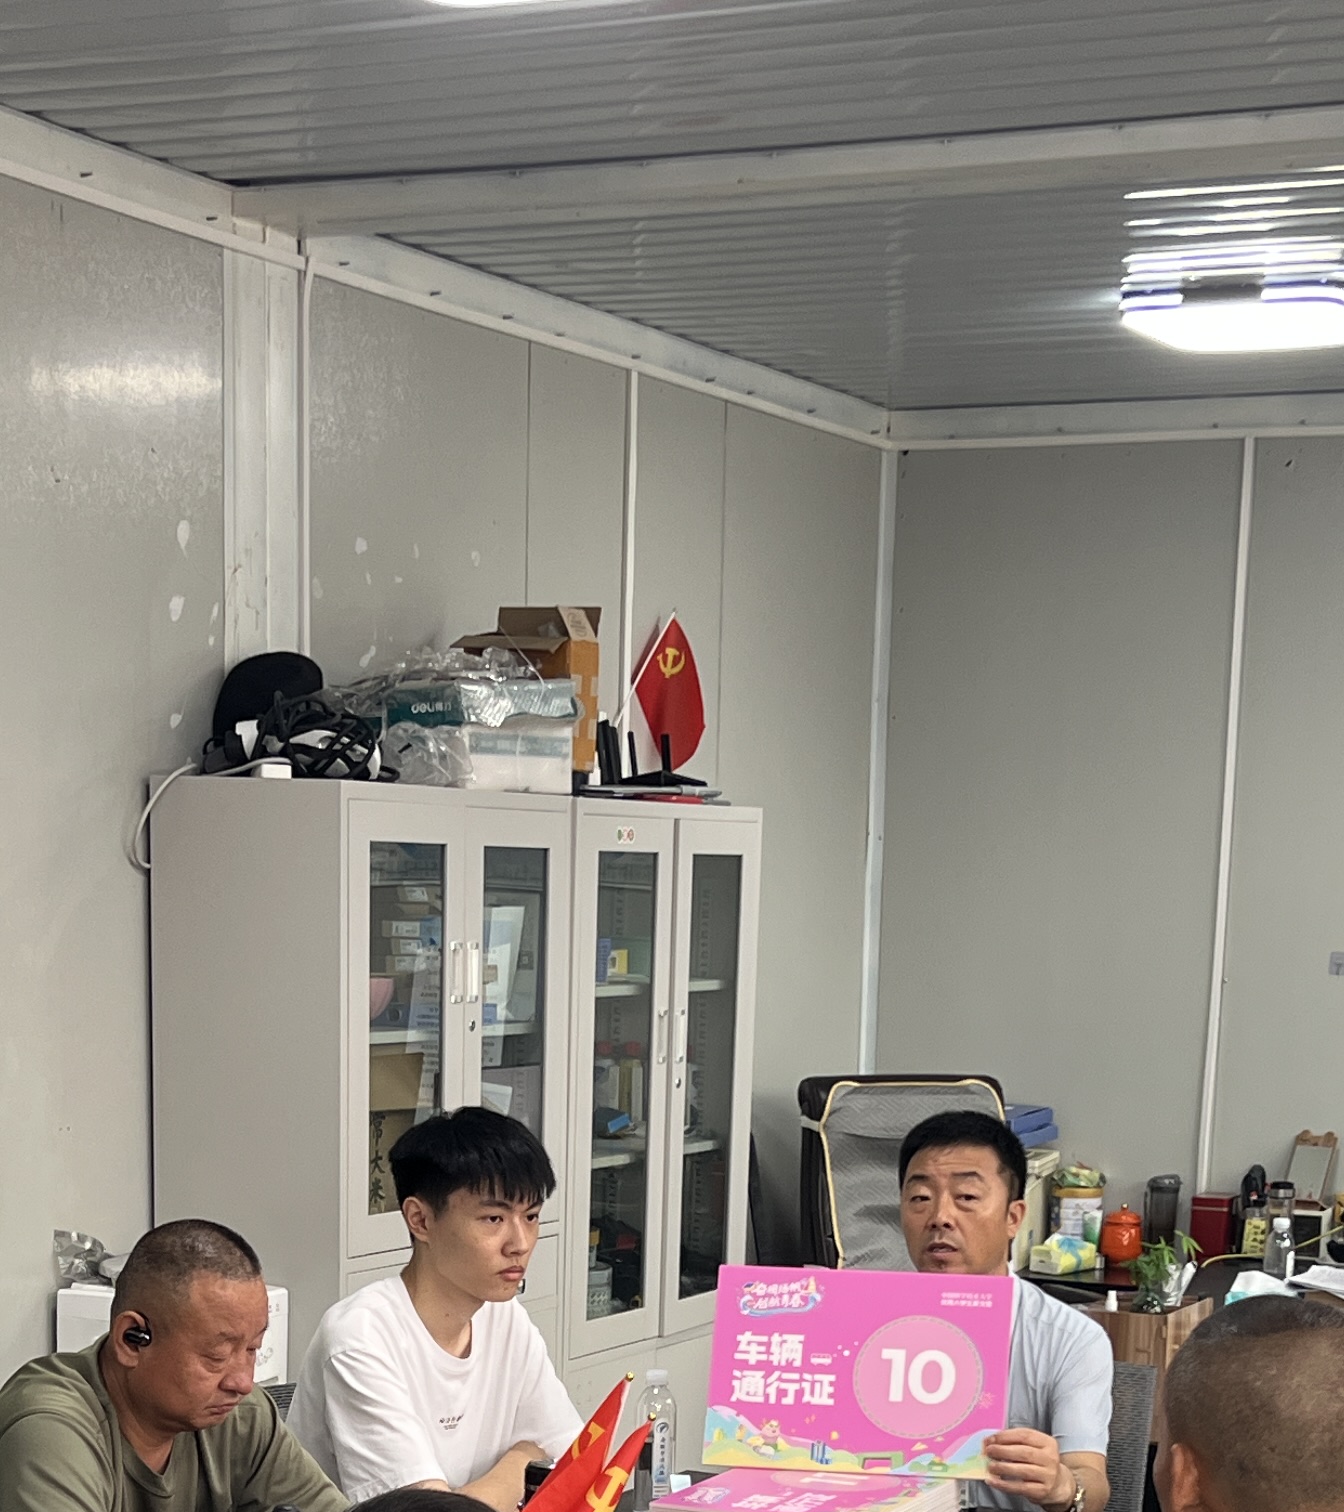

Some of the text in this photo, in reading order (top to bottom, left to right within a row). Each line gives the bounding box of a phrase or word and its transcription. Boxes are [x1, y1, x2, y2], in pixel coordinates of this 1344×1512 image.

[734, 1331, 805, 1367] 车辆
[731, 1369, 836, 1405] 通行证
[881, 1348, 957, 1405] 10
